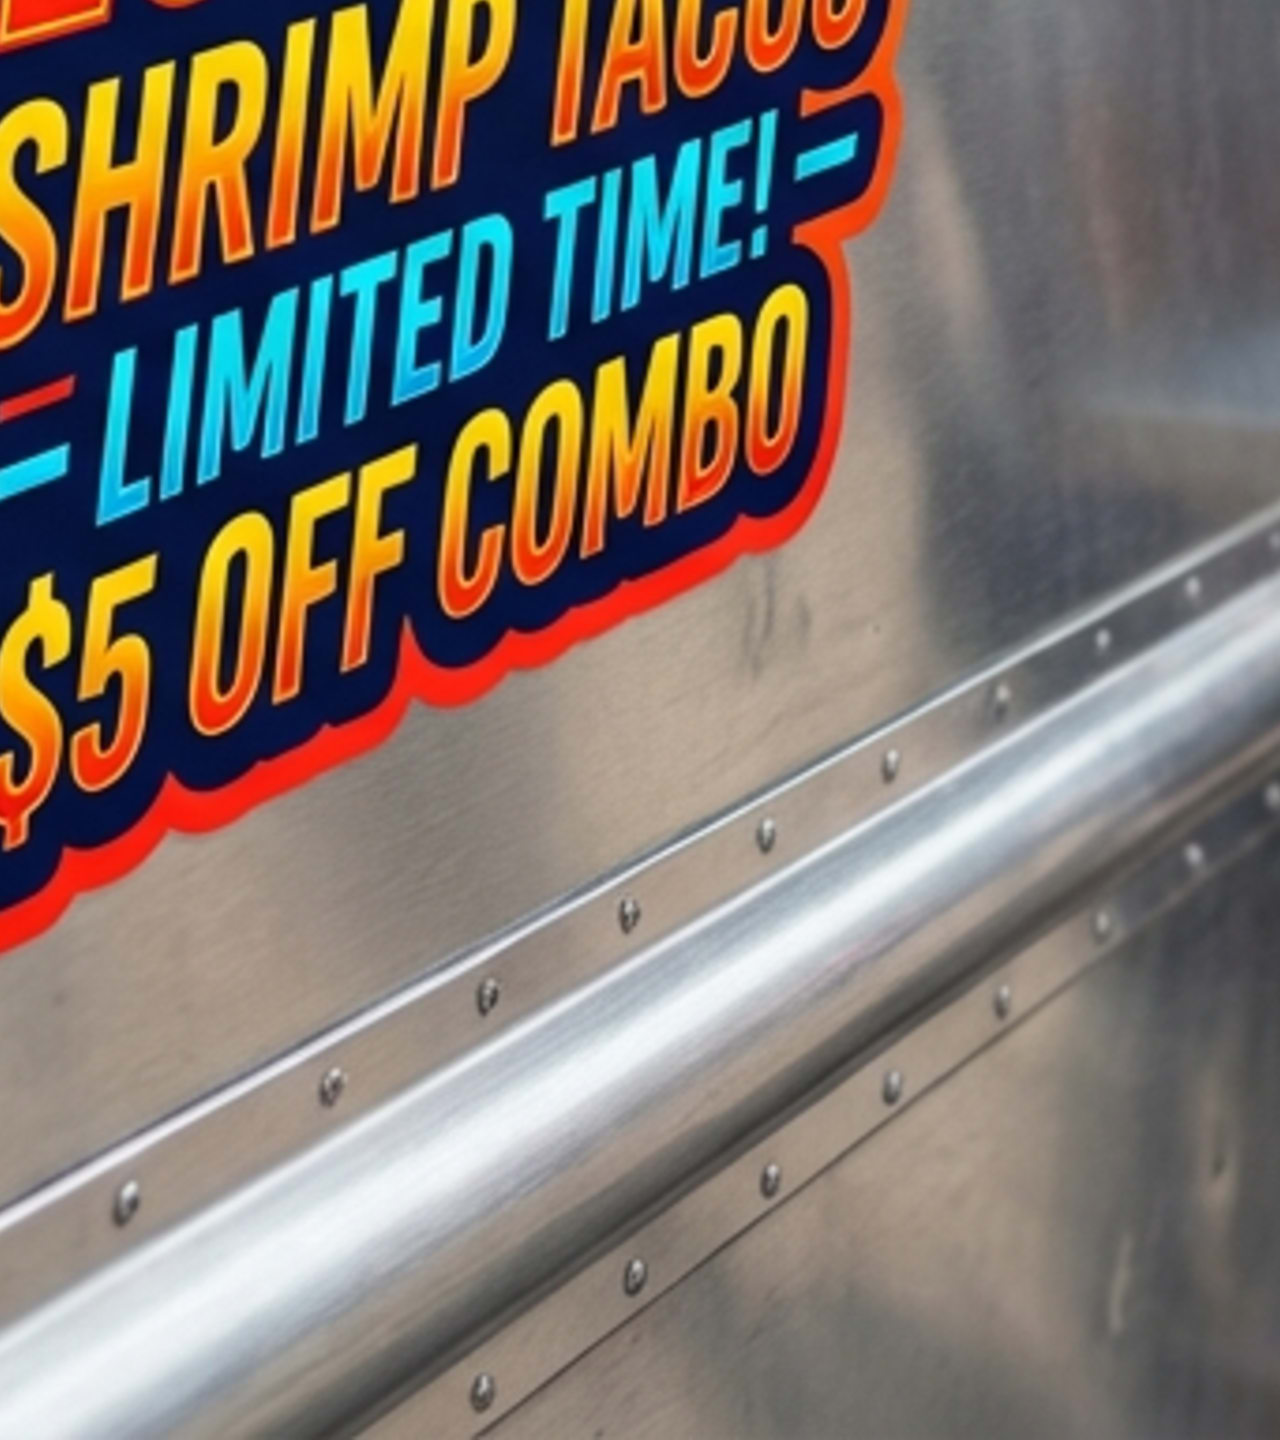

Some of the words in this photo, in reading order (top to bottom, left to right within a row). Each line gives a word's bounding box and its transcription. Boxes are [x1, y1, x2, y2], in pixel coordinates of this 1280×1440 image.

[94, 213, 514, 527] LIMITED
[542, 109, 780, 340] TIME!
[188, 444, 418, 737] OFF
[436, 283, 810, 619] COMBO
